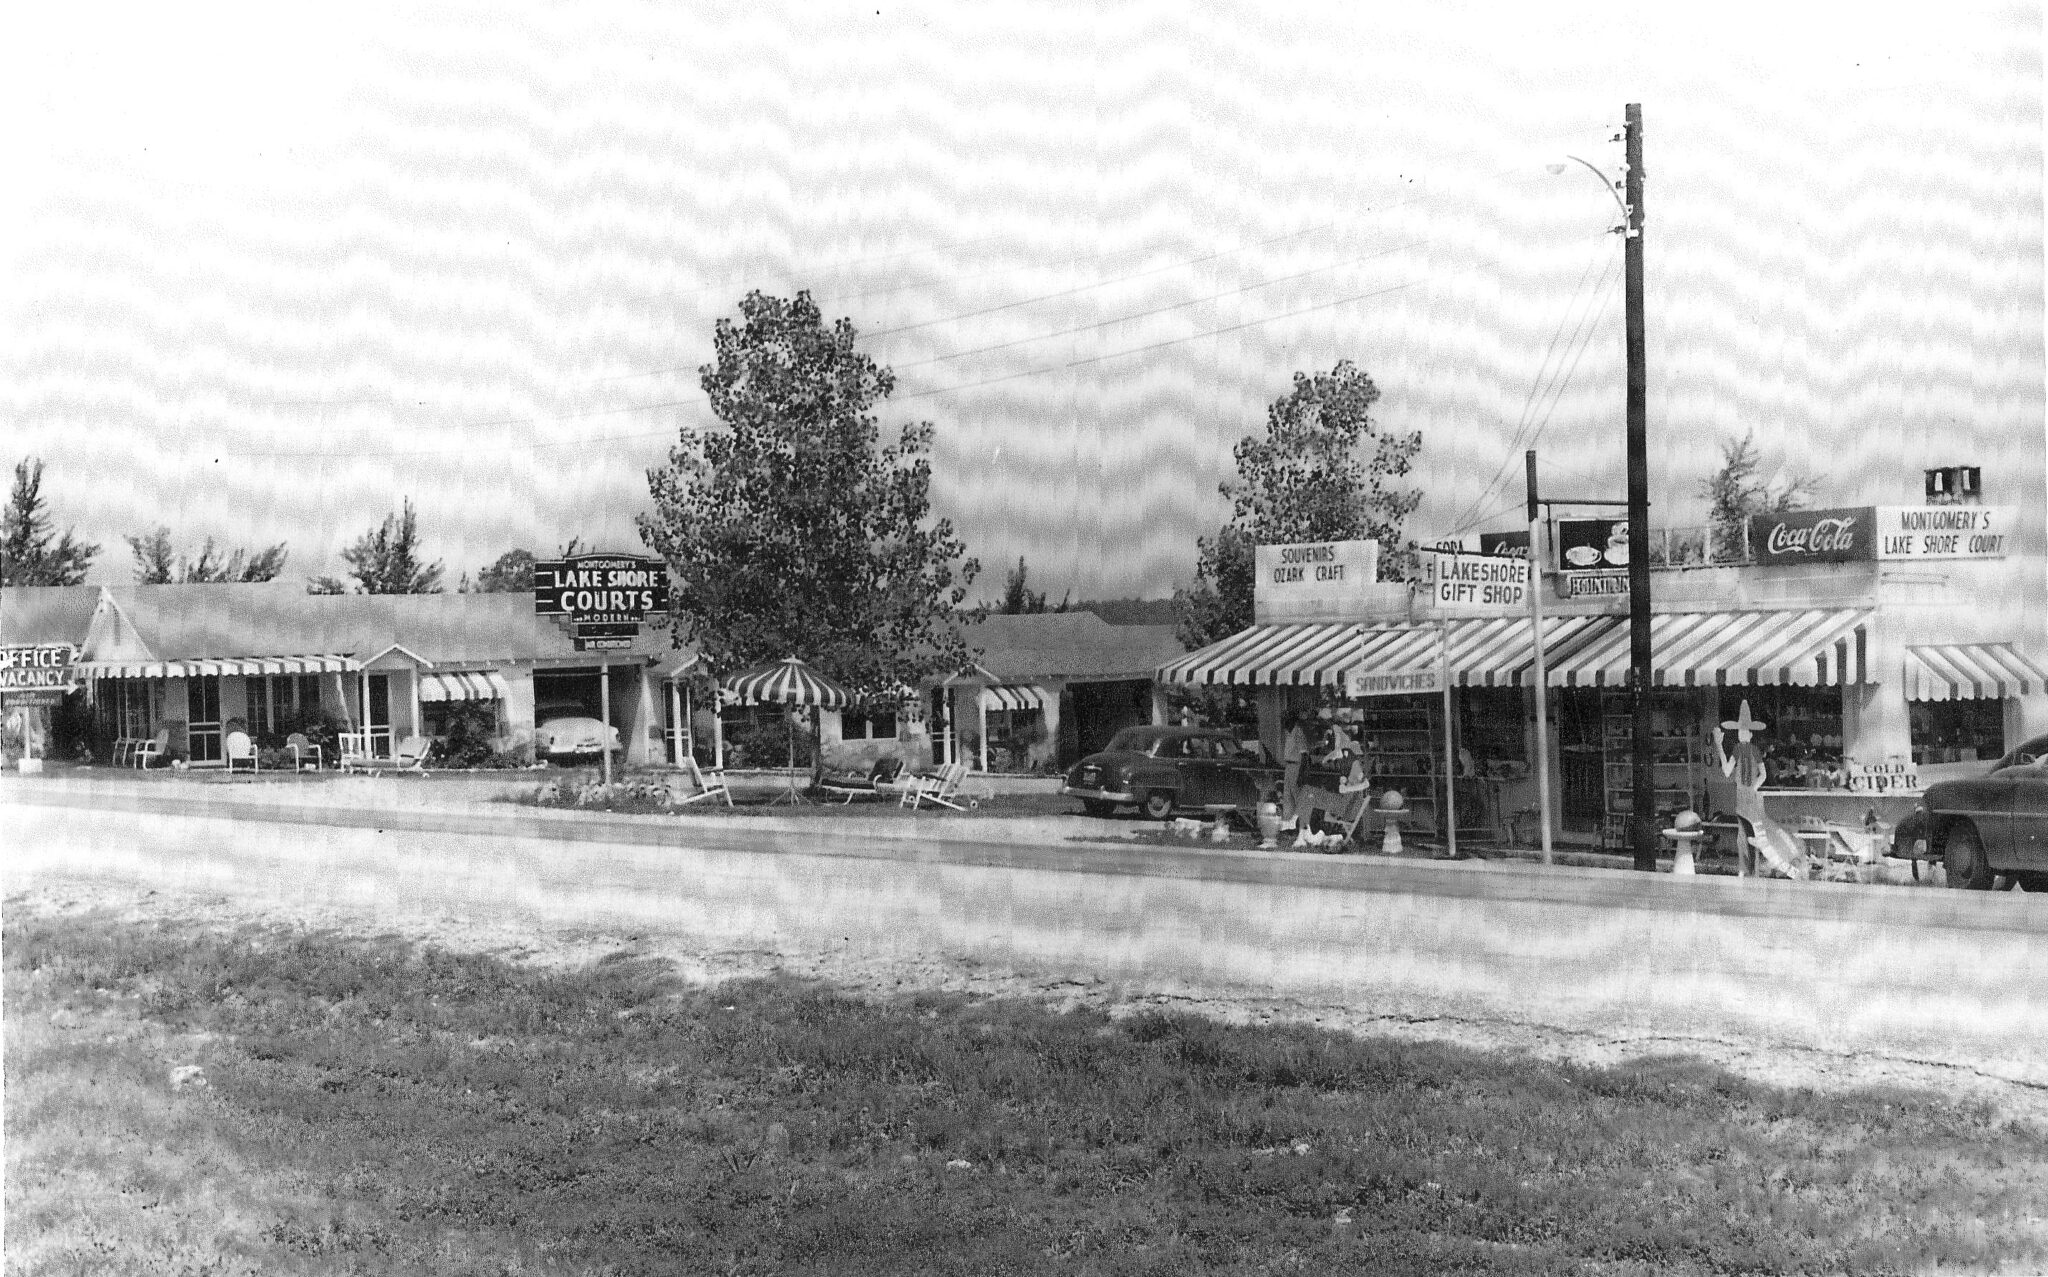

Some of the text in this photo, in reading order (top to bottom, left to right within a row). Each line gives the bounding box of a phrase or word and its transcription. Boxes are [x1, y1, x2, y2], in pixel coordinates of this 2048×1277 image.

[1901, 511, 1990, 530] MONTGOMERY'S
[1884, 534, 2004, 554] LAKE SHORE COURT
[1281, 545, 1335, 564] SOUVENIRS
[554, 571, 658, 588] LAKE SHORE
[1274, 565, 1344, 583] OZARK CRAFT
[1441, 561, 1525, 583] LAKESHORE
[560, 591, 653, 611] COURTS
[1441, 583, 1522, 604] GIFT SHOP
[584, 613, 629, 622] MODERN
[0, 670, 63, 686] VACANCY
[1863, 764, 1905, 774] COLD
[1852, 775, 1917, 789] CIDER
